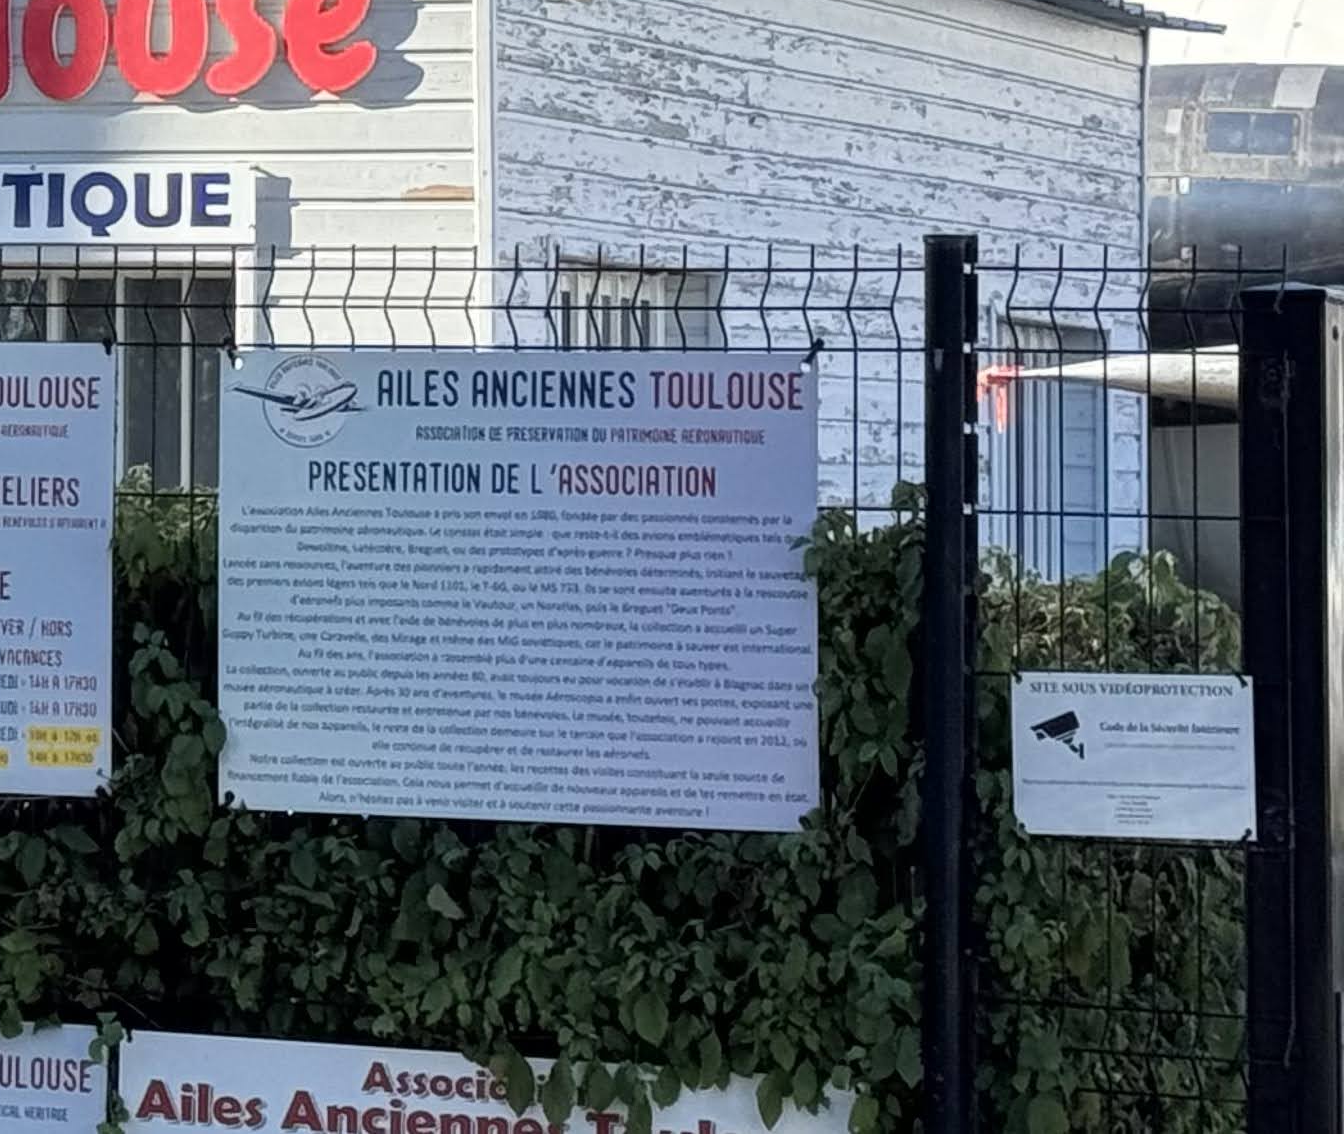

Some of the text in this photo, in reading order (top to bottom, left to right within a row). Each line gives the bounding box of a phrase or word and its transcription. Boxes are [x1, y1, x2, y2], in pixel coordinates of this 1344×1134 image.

[377, 369, 460, 407] AILES
[472, 370, 636, 409] ANCIENNES
[649, 371, 804, 411] TOULOUSE
[416, 425, 486, 441] ASSOCIATION
[507, 426, 589, 443] PRESERVATION
[592, 427, 607, 443] DU
[611, 427, 677, 444] PATRIMOINE
[309, 460, 481, 494] PRESENTATION
[492, 462, 520, 494] DE
[531, 463, 543, 495] L
[41, 620, 73, 638] HORS
[0, 648, 63, 667] VACANCES
[1029, 681, 1233, 697] SITE SOUS VIDÉOPROTECTION
[136, 1077, 265, 1128] Ailes
